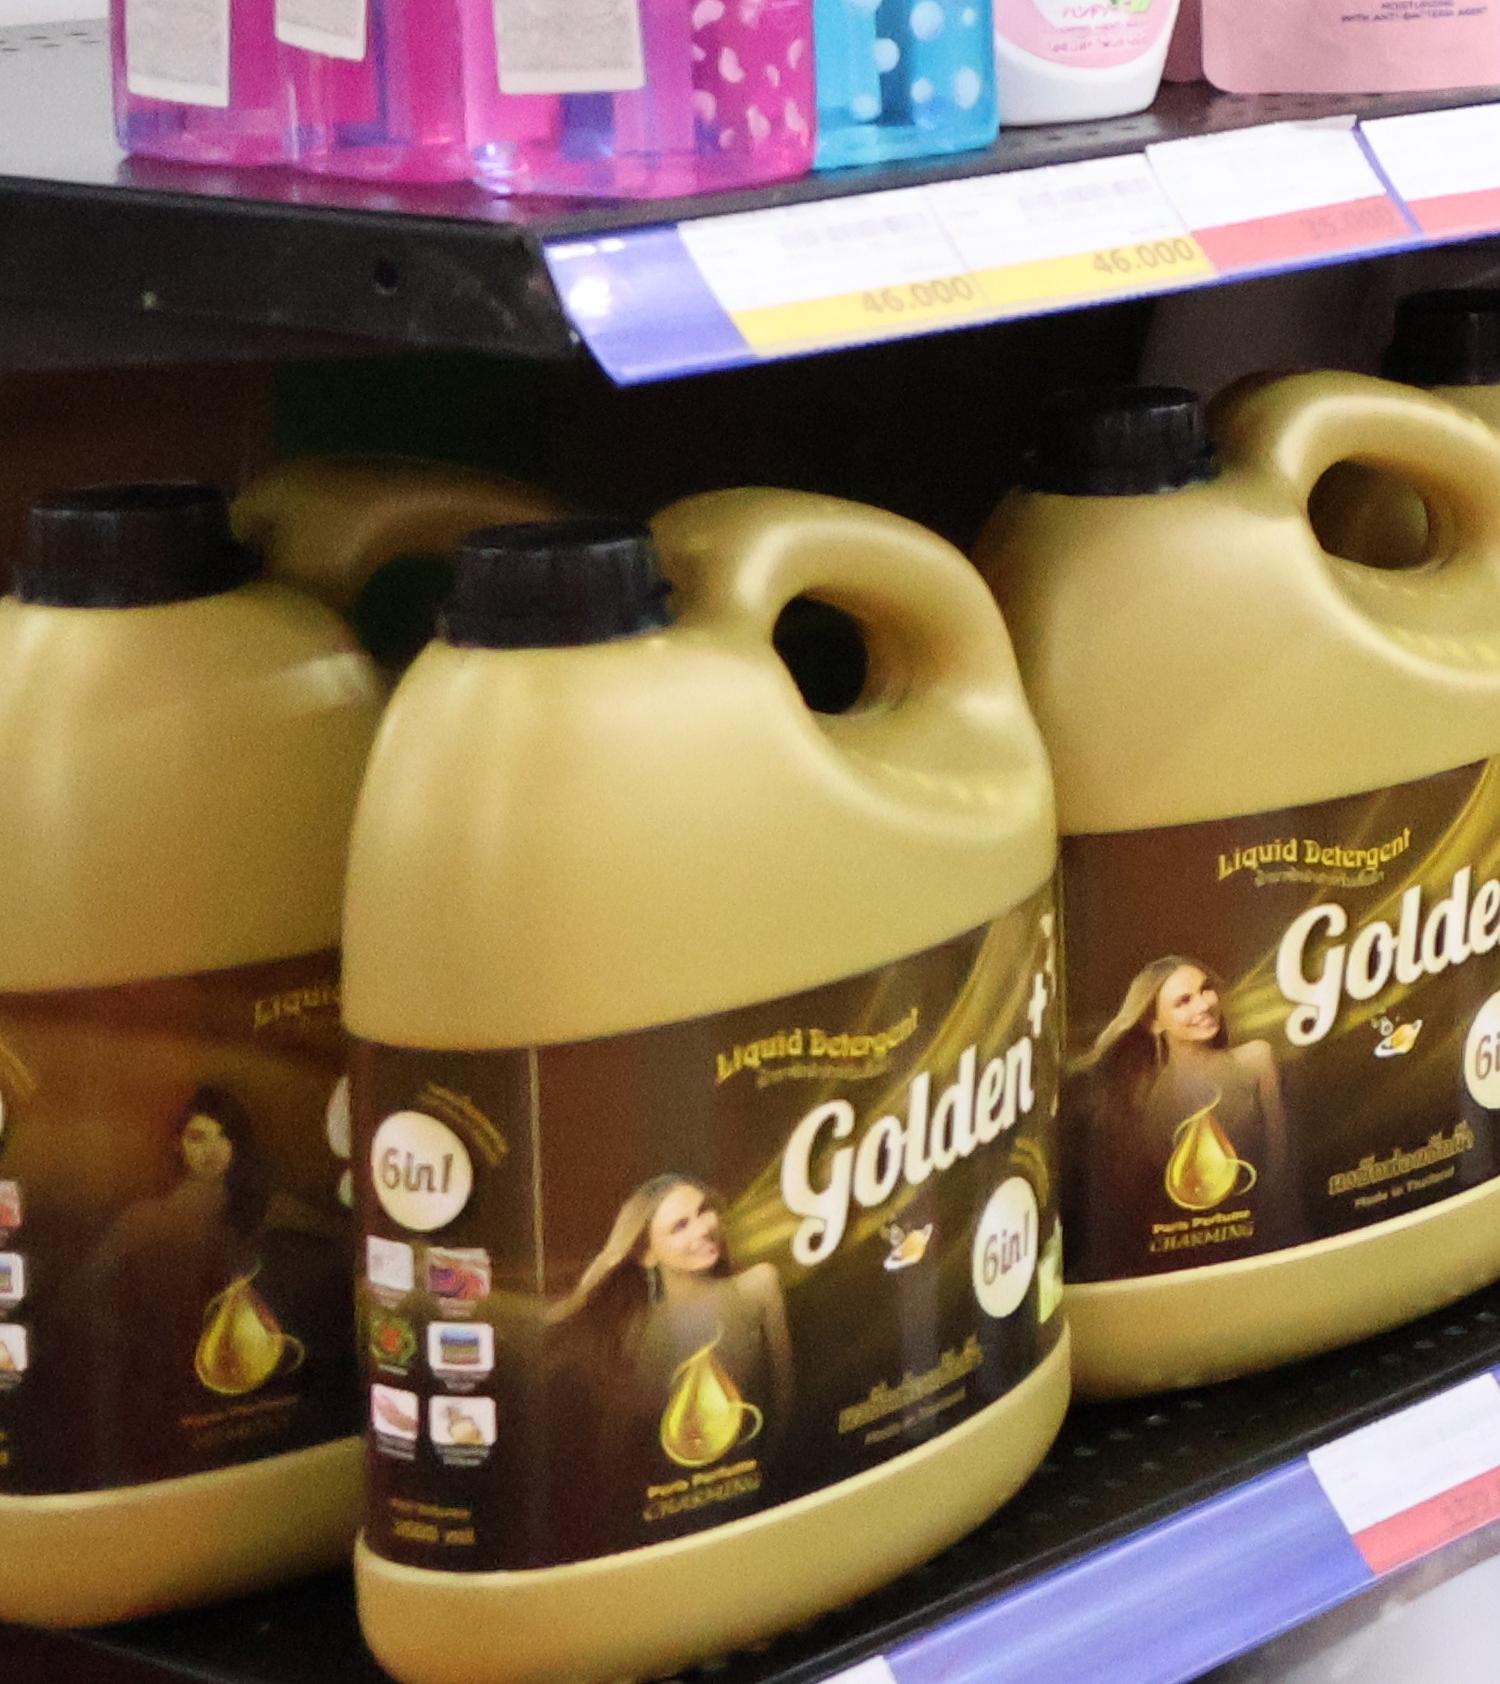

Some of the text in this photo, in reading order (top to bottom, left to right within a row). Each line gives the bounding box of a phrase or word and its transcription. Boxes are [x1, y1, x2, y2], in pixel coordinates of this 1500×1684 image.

[1092, 237, 1195, 275] 46.000
[862, 275, 974, 316] 46.000
[1217, 828, 1411, 881] Liquid Detergent
[716, 1006, 919, 1084] Liquid Detergent
